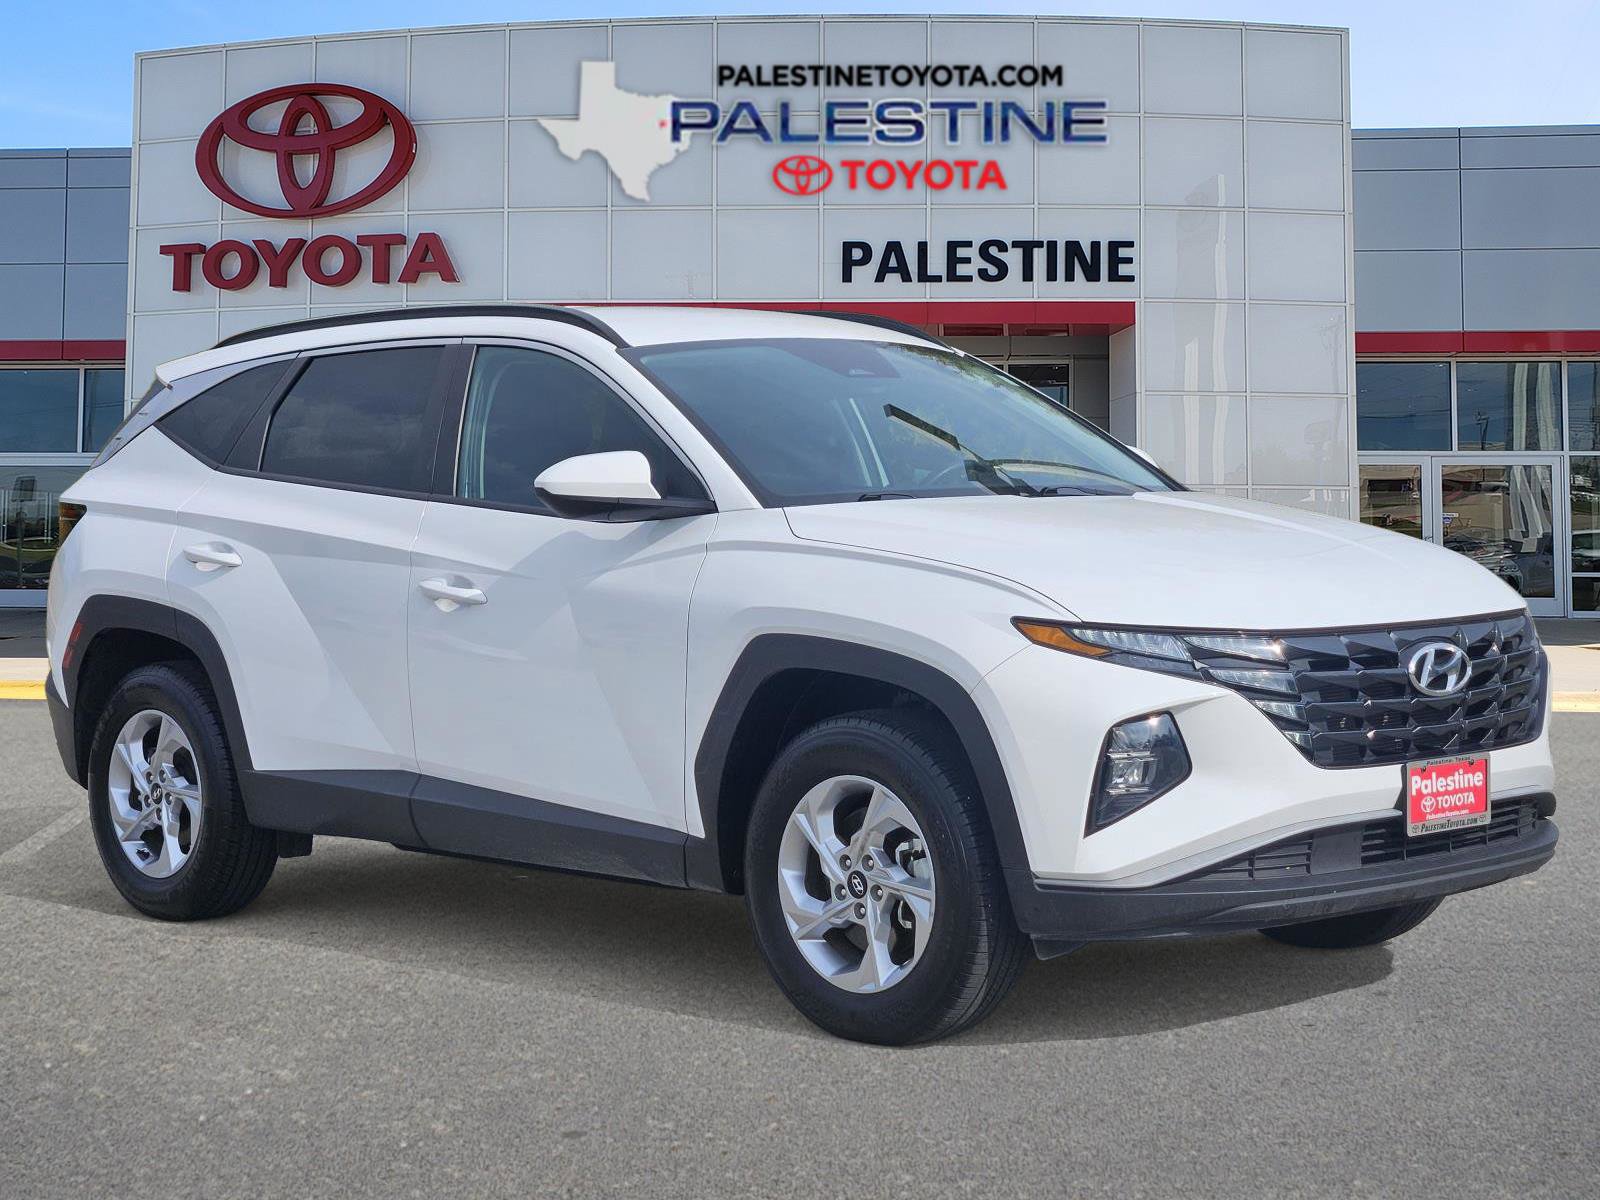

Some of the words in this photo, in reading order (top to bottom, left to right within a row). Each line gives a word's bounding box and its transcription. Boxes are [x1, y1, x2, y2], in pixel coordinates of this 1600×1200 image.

[160, 232, 460, 292] TOYOTA
[842, 240, 1136, 283] PALESTINE
[1411, 768, 1484, 796] Palestine
[1437, 792, 1475, 809] TOYOTA
